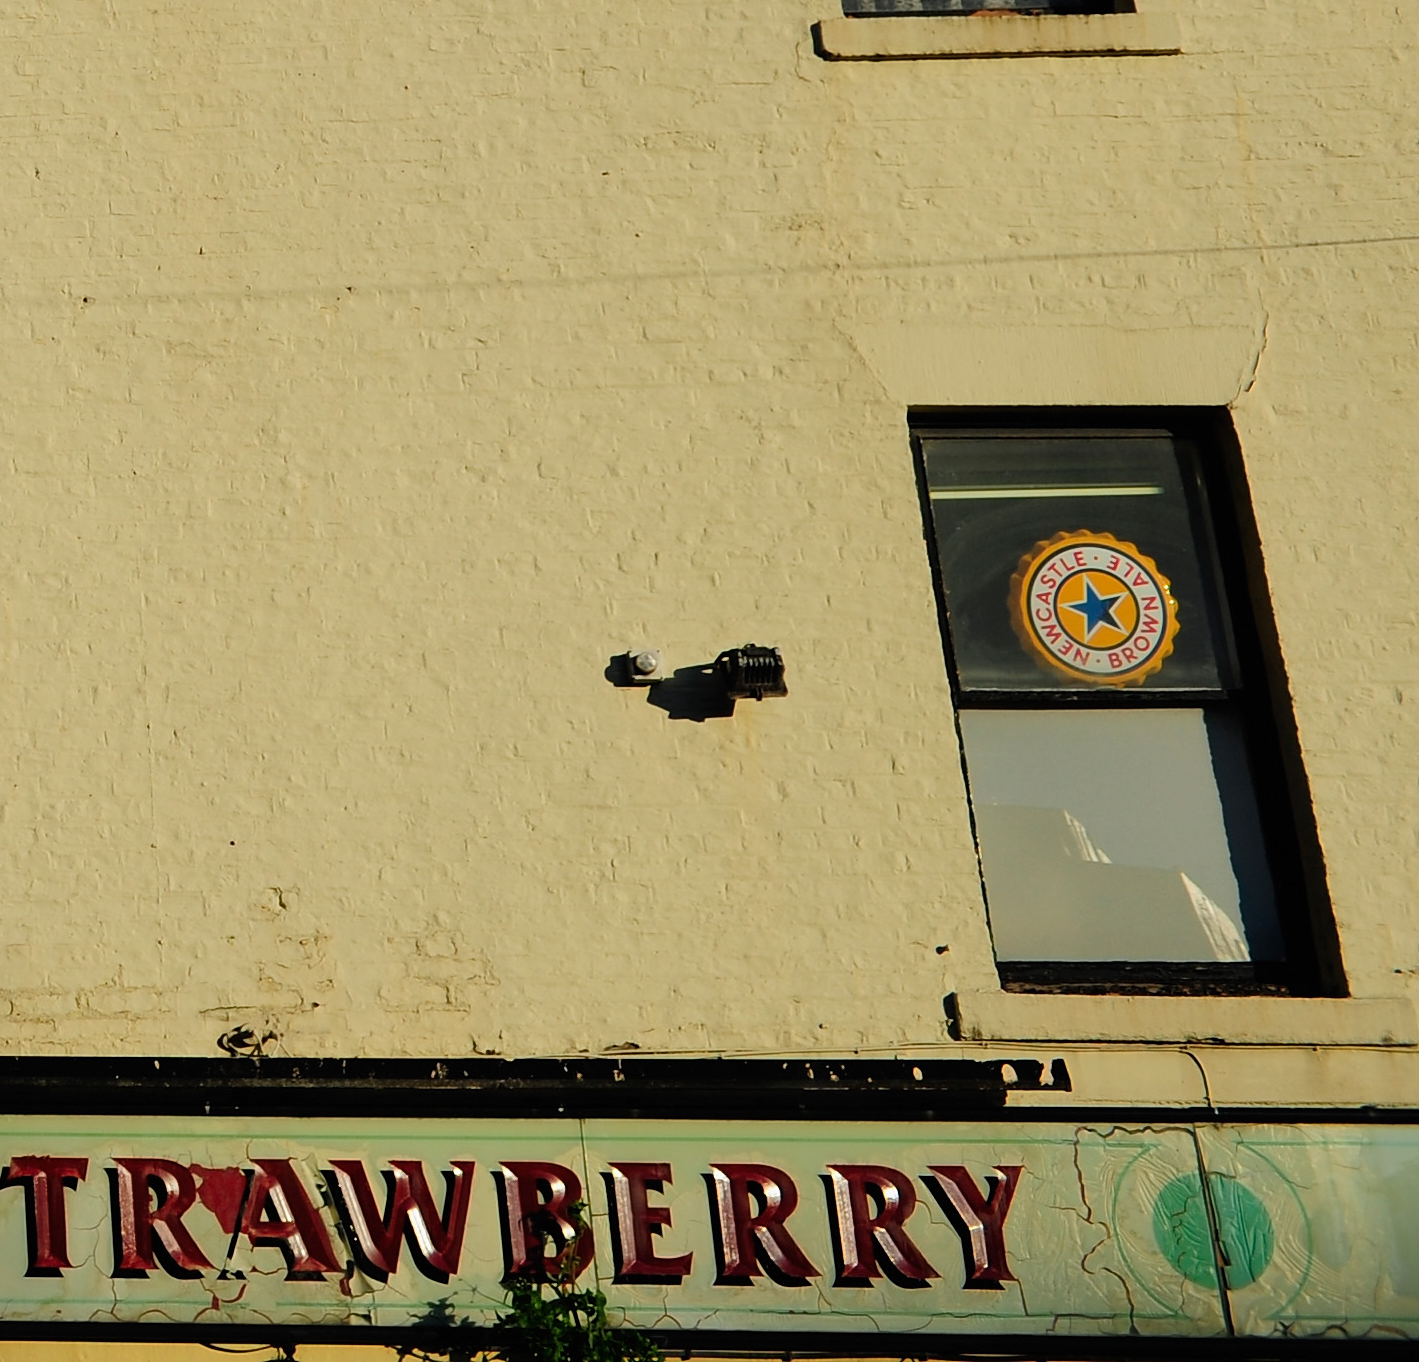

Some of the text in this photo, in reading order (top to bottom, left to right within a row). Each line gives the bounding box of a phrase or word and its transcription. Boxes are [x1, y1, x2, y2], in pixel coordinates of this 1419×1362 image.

[1035, 551, 1091, 666] NEWCASTLE
[1106, 554, 1160, 669] BROWN ALE
